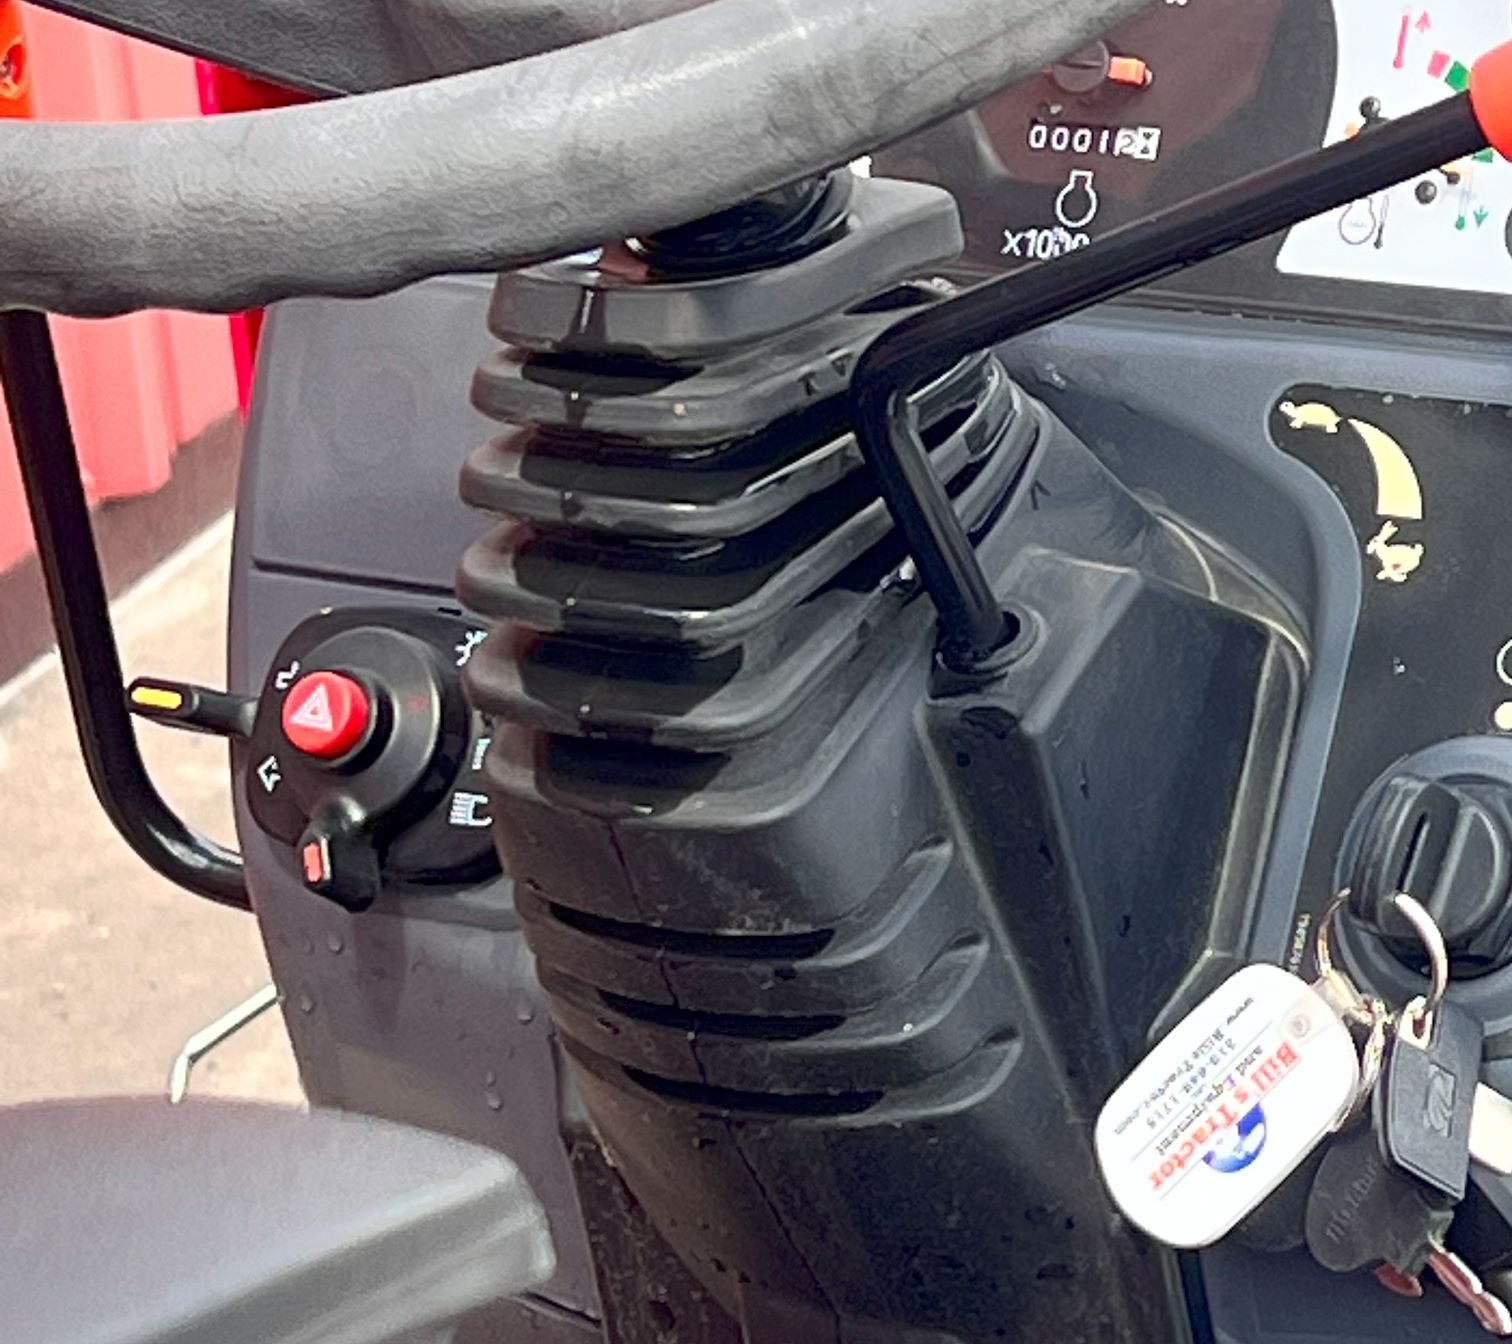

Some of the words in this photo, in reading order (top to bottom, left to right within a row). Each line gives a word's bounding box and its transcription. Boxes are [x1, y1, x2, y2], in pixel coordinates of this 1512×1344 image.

[1234, 1042, 1299, 1104] Bill's
[1150, 1104, 1238, 1189] Tractor
[1156, 1074, 1236, 1155] Equipment
